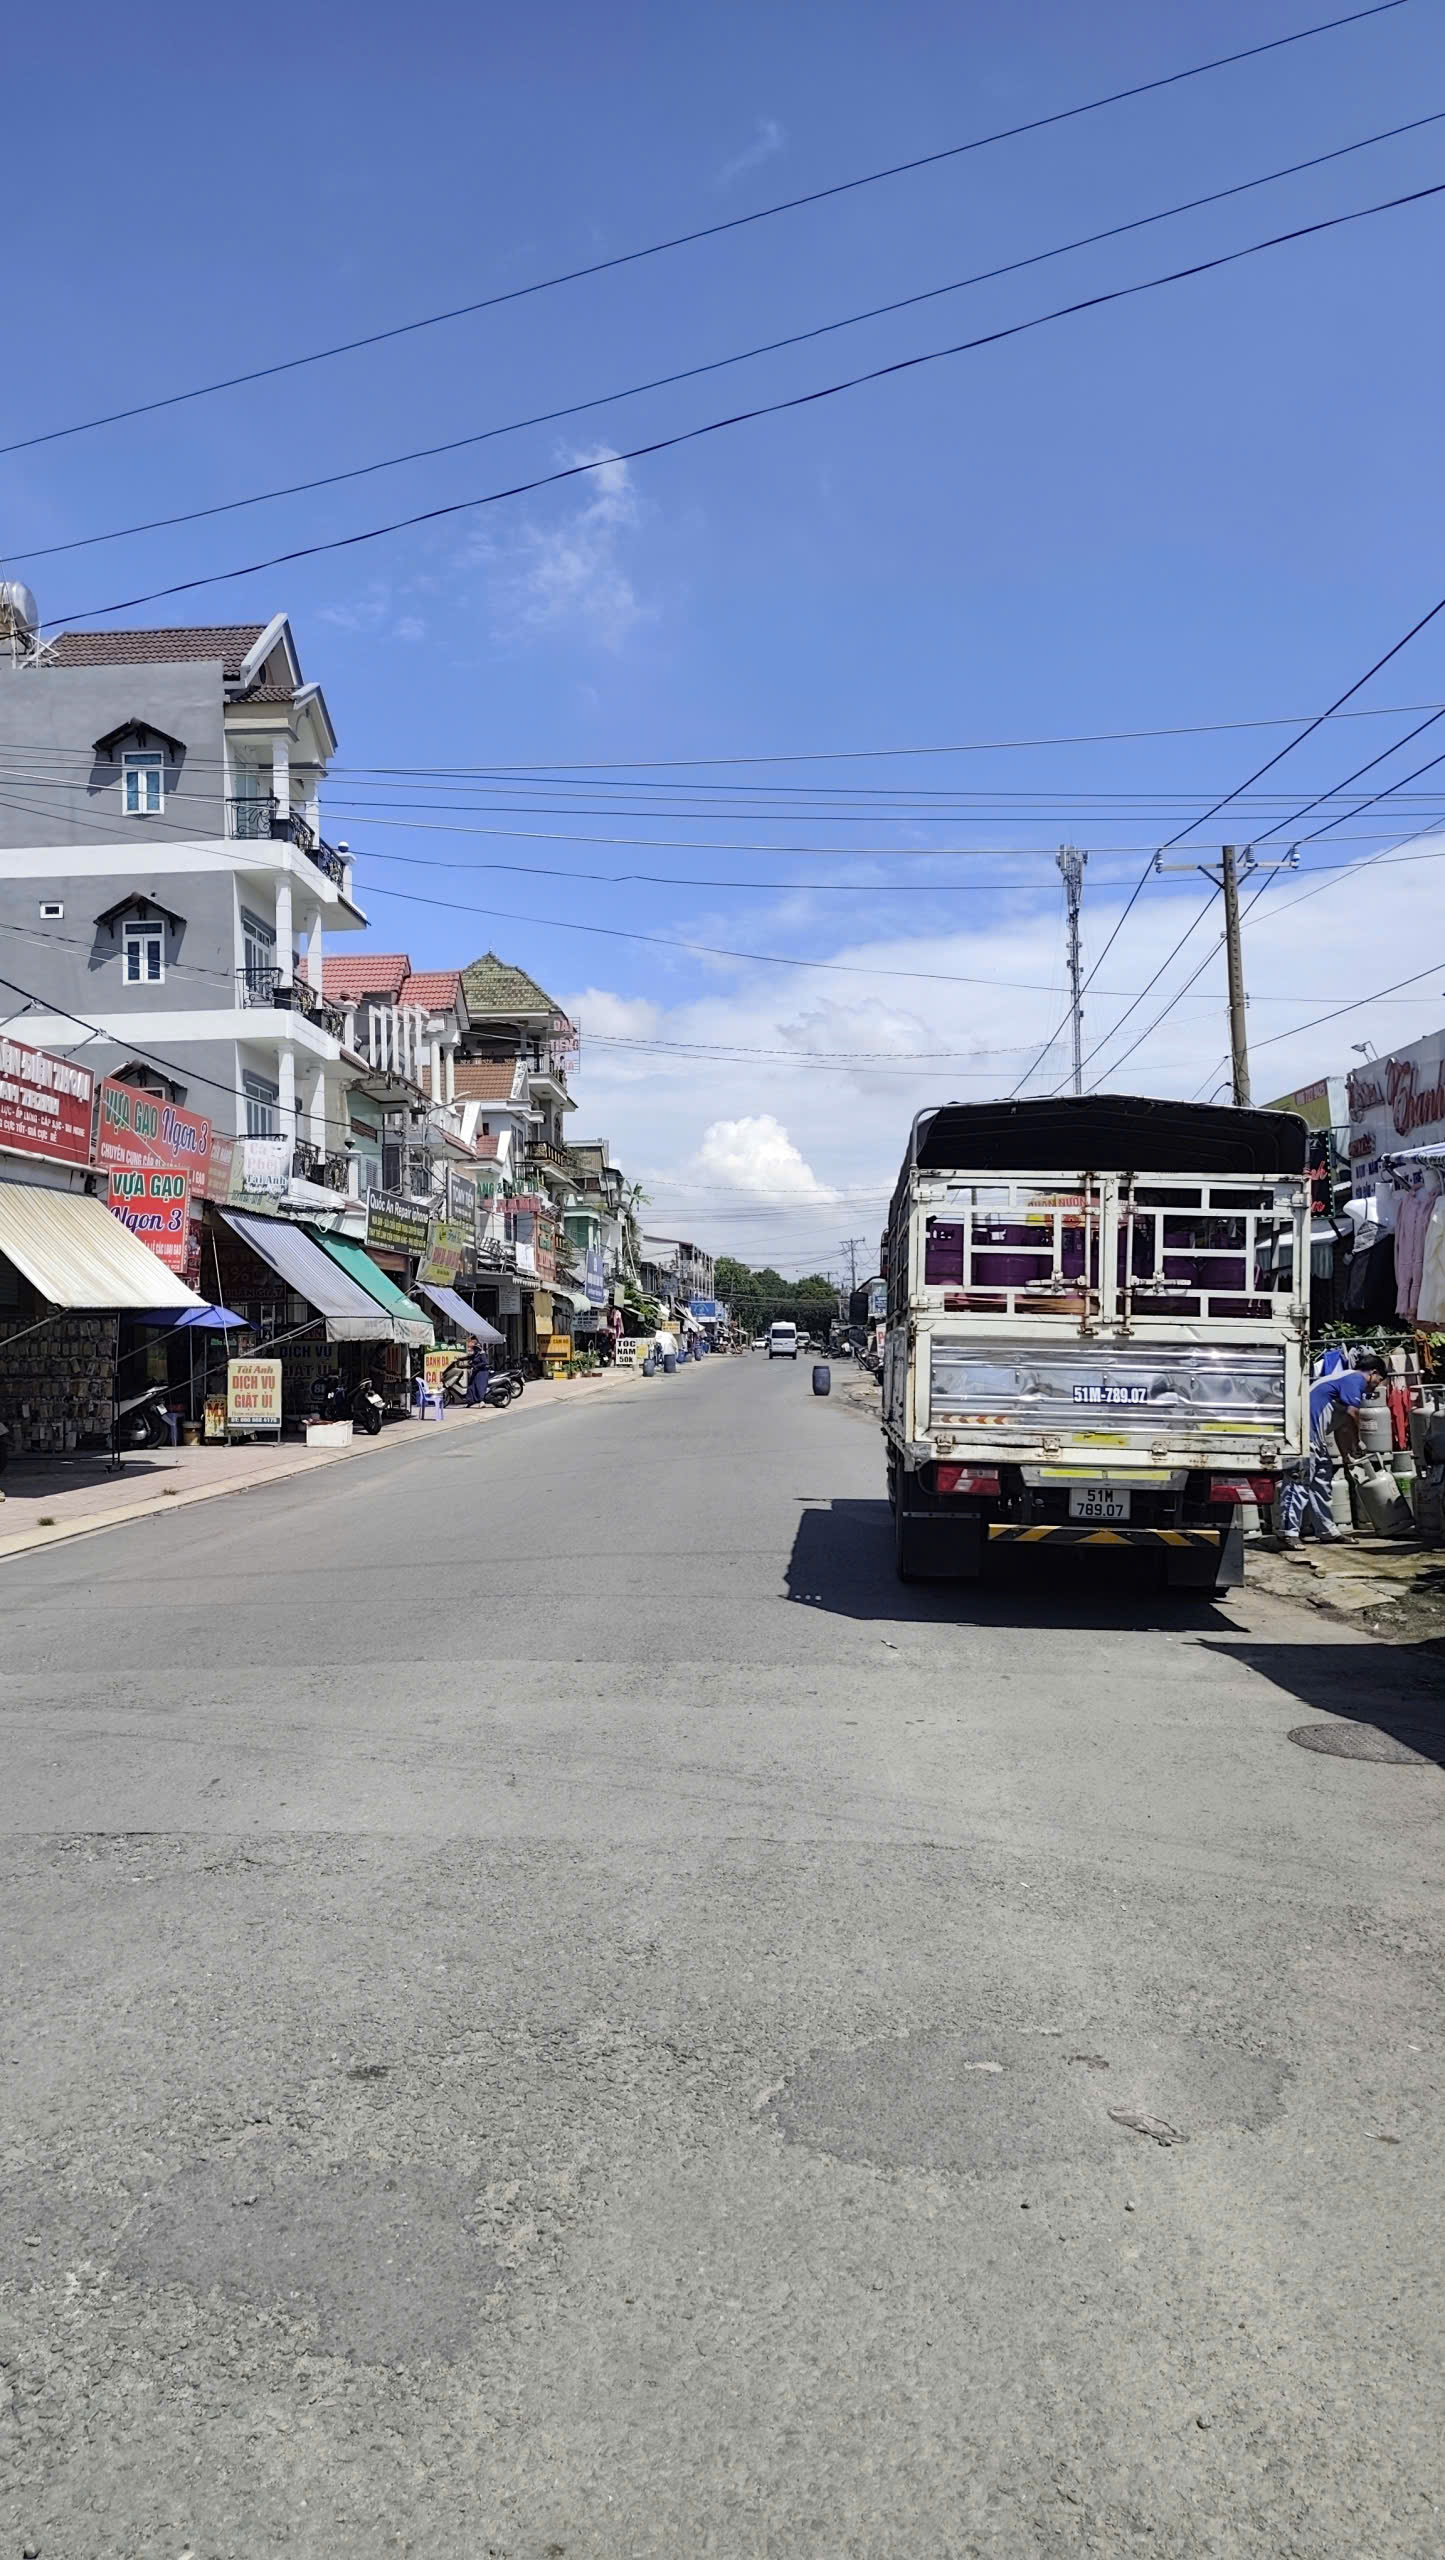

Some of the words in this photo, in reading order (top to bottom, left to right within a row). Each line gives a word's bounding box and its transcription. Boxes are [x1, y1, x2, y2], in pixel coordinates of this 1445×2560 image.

[105, 1087, 131, 1135] VỰA
[134, 1100, 160, 1143] GẠO
[162, 1106, 197, 1157] Ngon
[198, 1120, 208, 1155] 3
[112, 1171, 146, 1202] VỰA
[149, 1174, 185, 1203] GẠO
[370, 1192, 386, 1212] Quốc
[386, 1199, 395, 1213] An
[168, 1208, 183, 1232] 3
[237, 1365, 252, 1374] Tài
[254, 1365, 274, 1374] Anh
[232, 1375, 258, 1392] DỊCH
[261, 1375, 276, 1392] VỤ
[234, 1391, 259, 1411] GIẶT
[261, 1391, 273, 1409] ỦI
[1074, 1387, 1147, 1404] 51M-789.07
[1087, 1489, 1114, 1503] 51M
[1076, 1502, 1124, 1517] 789.07
